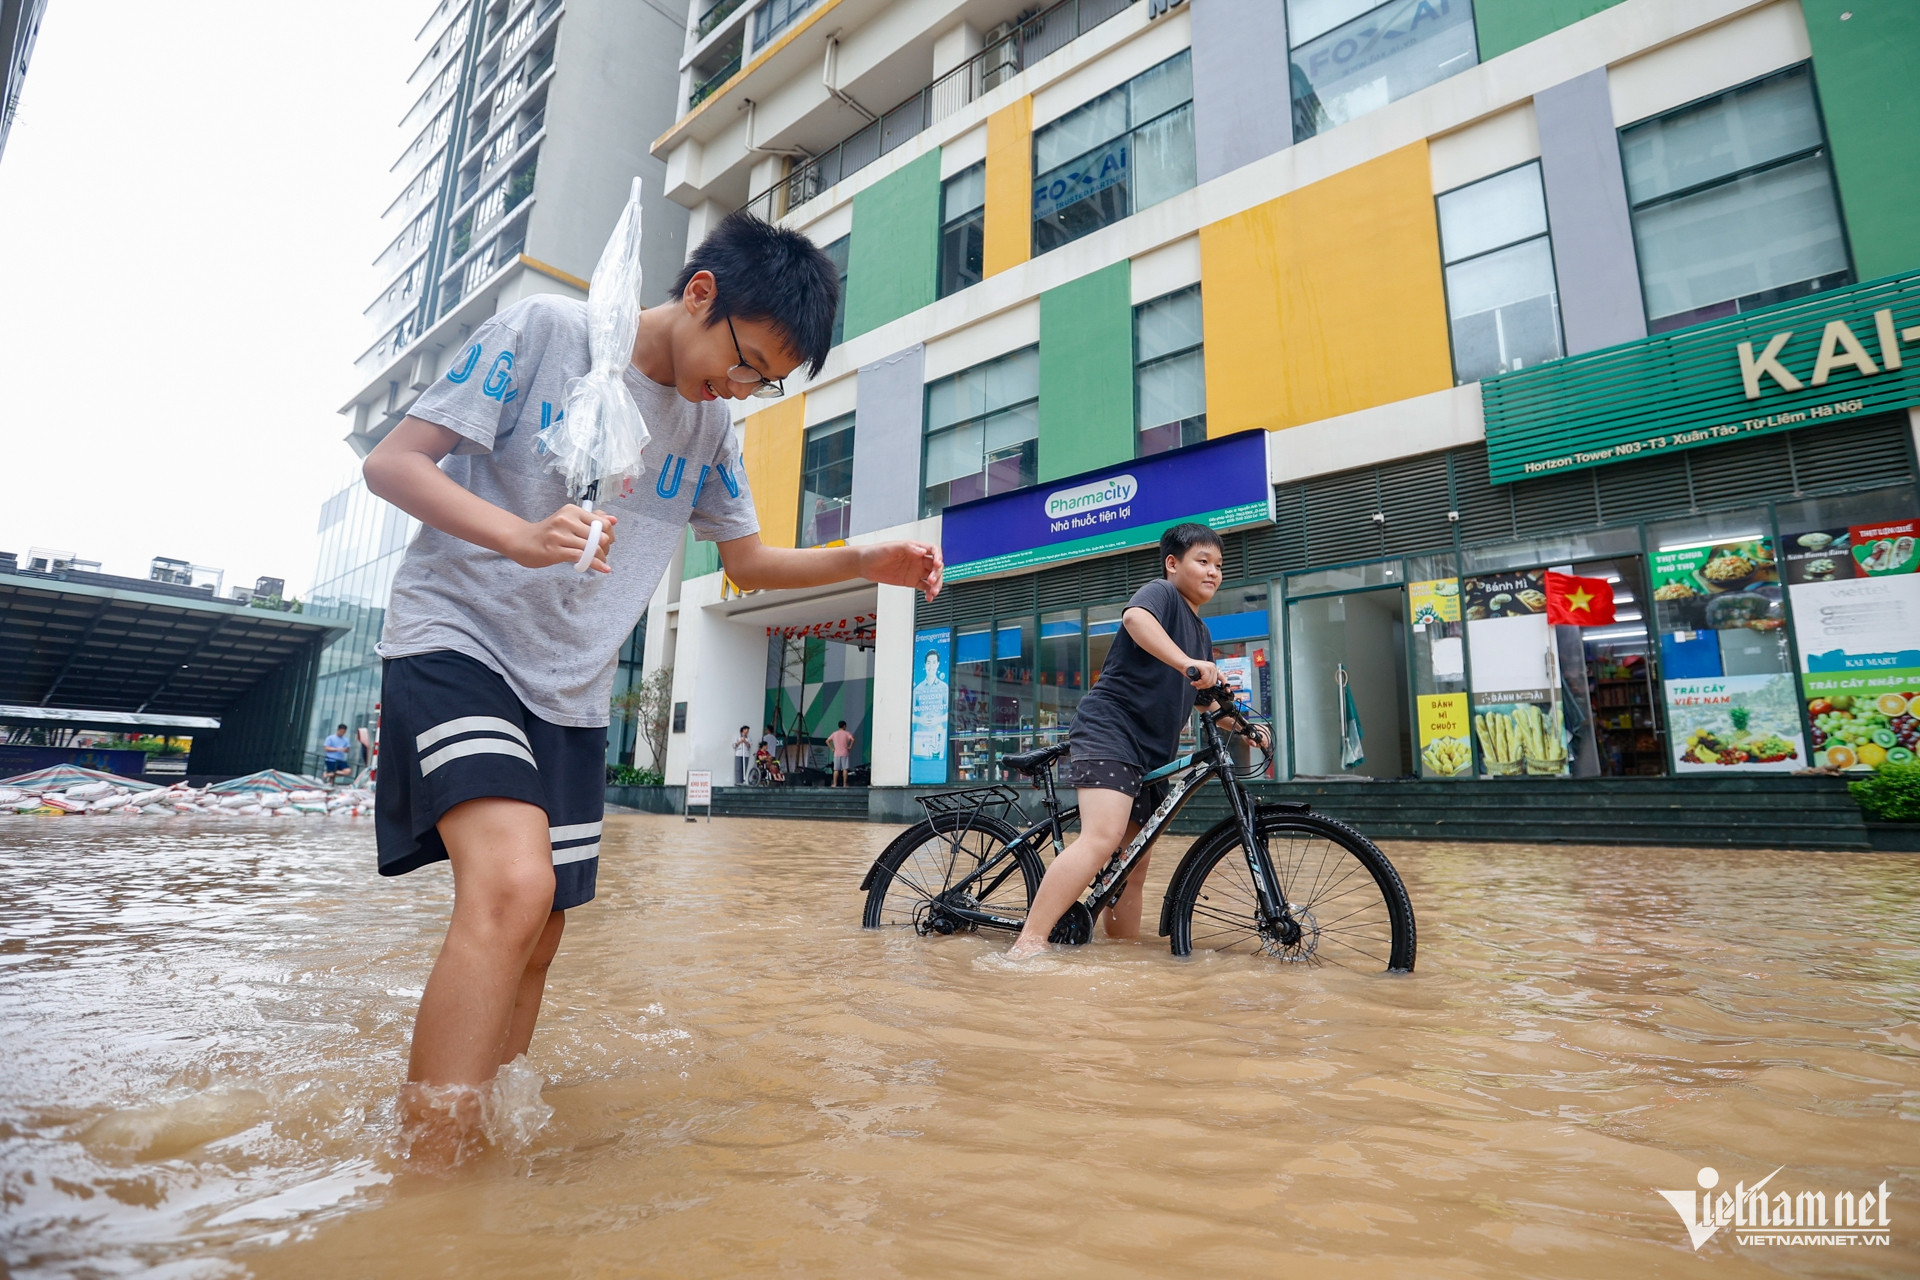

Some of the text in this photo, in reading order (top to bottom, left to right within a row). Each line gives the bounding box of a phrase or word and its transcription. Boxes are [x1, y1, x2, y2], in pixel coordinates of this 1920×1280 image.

[1055, 189, 1090, 209] TRUSTED
[1090, 172, 1126, 195] PARTNER
[1524, 456, 1572, 473] Horizon
[1574, 448, 1614, 464] Tower
[1615, 437, 1667, 456] N03-T3
[1672, 430, 1709, 446] Xuân
[1743, 418, 1767, 431] Từ
[1768, 411, 1806, 427] Liêm
[1810, 406, 1834, 419] Hà
[1834, 399, 1863, 415] Nội
[1050, 482, 1131, 514] Pharmacity
[1050, 505, 1131, 533] Nhà thuốc tiện lợi
[1677, 551, 1703, 562] CHUA
[1485, 578, 1529, 593] Bánh Mì
[1865, 656, 1898, 667] MART
[1673, 683, 1726, 695] TRÁI CÂY
[1808, 680, 1839, 691] TRÁI
[1839, 677, 1865, 689] CÂY
[1867, 675, 1906, 688] NHẬP
[1491, 692, 1515, 703] BÁNH
[1674, 695, 1731, 708] VIỆT NAM
[1431, 700, 1454, 710] BÁNH
